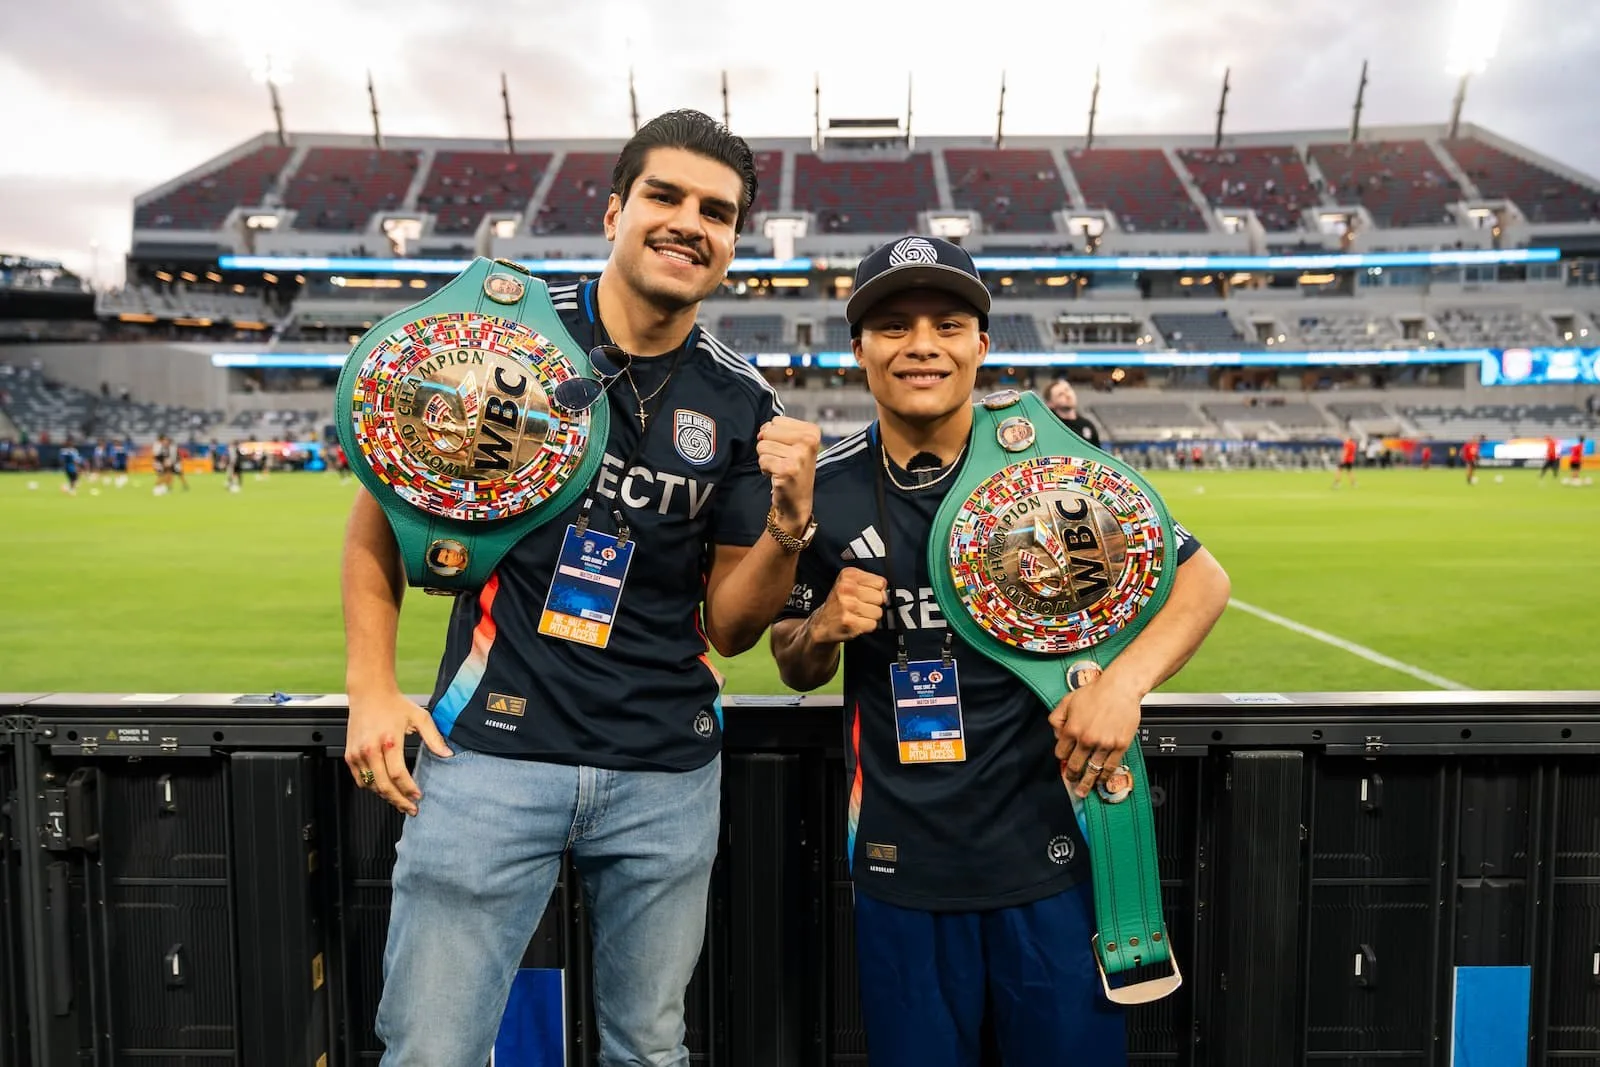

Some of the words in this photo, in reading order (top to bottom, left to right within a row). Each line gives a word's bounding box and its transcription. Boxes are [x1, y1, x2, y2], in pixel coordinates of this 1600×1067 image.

[398, 350, 485, 416] CHAMPION
[474, 366, 527, 470] WBC
[678, 414, 693, 425] SAN
[693, 416, 713, 433] DIEGO
[401, 423, 462, 478] WORLD
[595, 452, 715, 520] ECTV
[990, 495, 1042, 583] CHAMPION
[1054, 498, 1109, 598] WBC
[1005, 584, 1070, 614] WORLD
[485, 719, 517, 732] AEROREADY
[1053, 842, 1069, 858] SD
